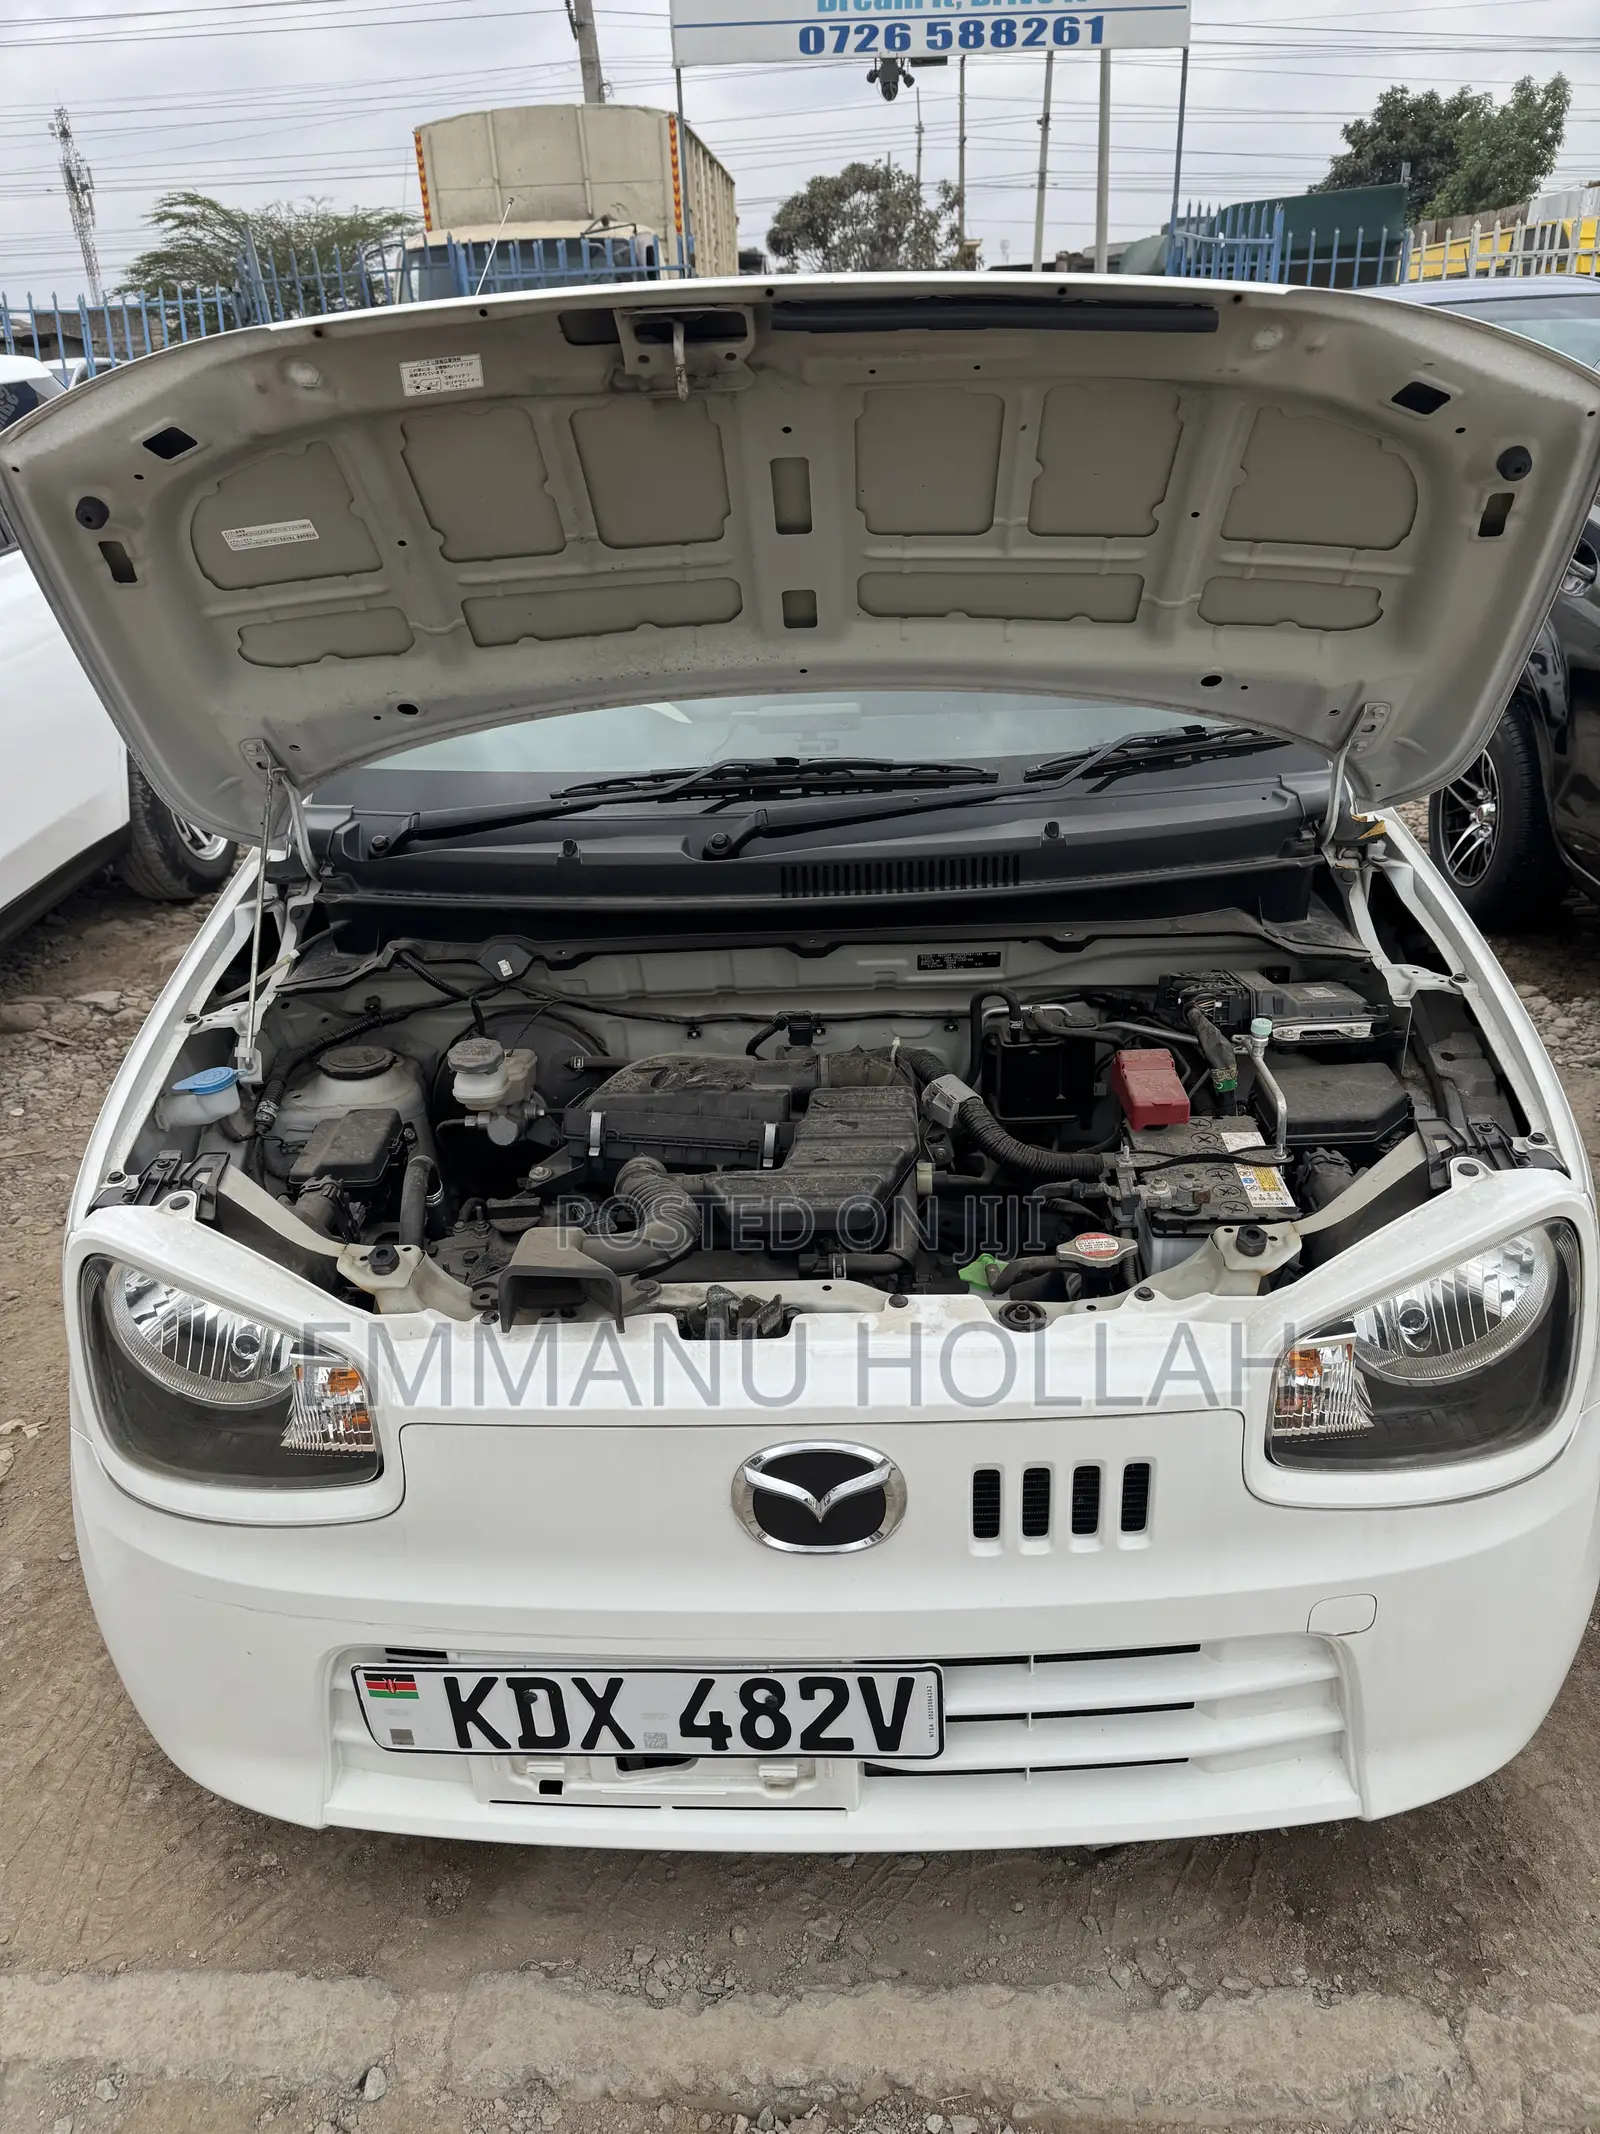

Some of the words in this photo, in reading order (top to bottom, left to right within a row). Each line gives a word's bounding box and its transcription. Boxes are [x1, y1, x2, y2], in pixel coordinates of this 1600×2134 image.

[799, 22, 911, 55] 0726
[926, 16, 1104, 50] 588261
[443, 1675, 636, 1750] KDX
[679, 1676, 916, 1752] 482V
